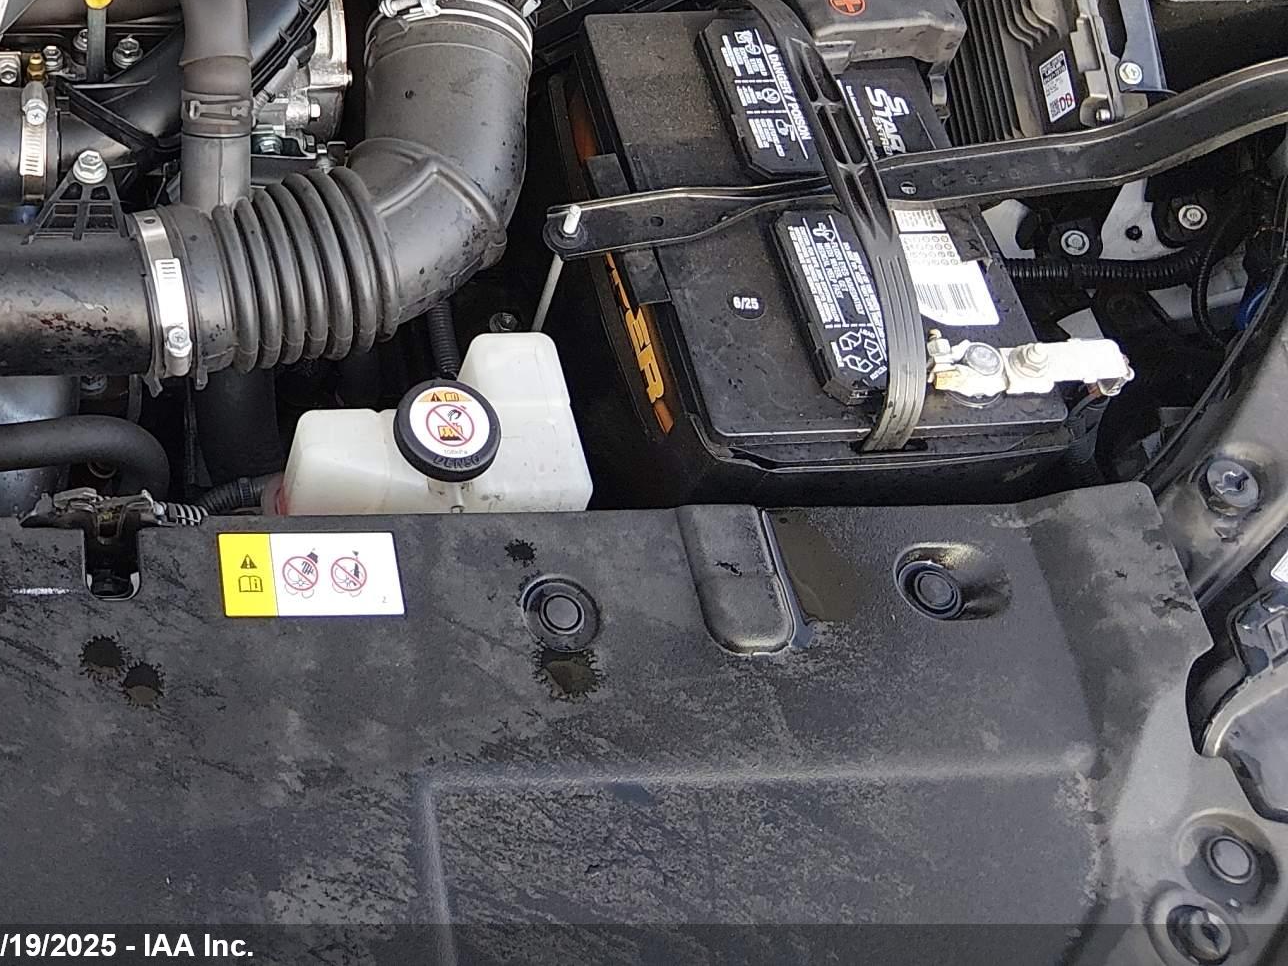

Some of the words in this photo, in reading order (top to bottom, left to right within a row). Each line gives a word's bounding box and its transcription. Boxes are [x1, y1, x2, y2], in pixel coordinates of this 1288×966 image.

[768, 54, 793, 94] DANGER
[787, 103, 812, 139] POISON
[872, 116, 893, 155] EXTRE
[733, 296, 760, 310] 6/25
[432, 455, 481, 469] DENSO
